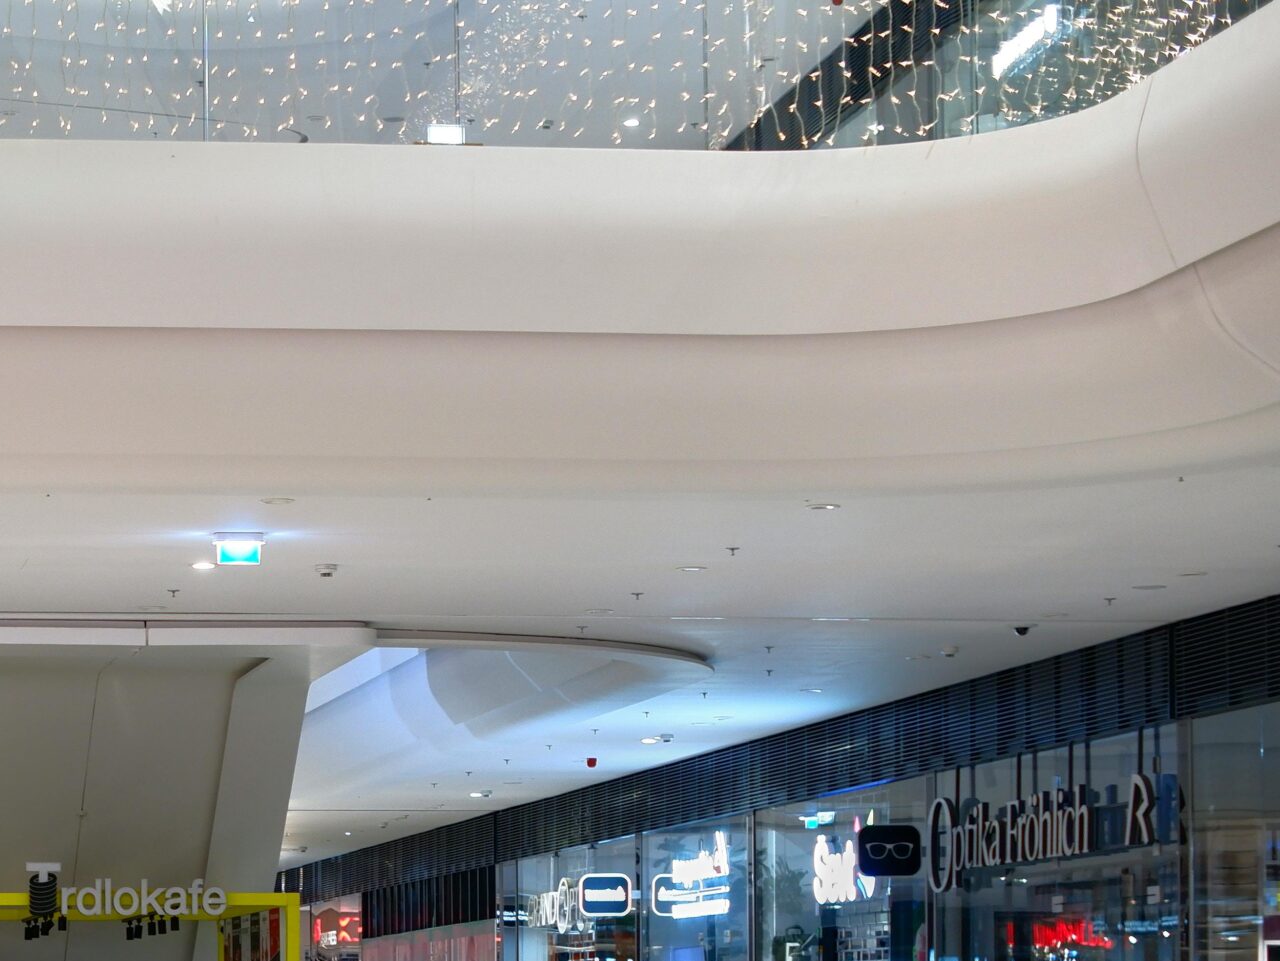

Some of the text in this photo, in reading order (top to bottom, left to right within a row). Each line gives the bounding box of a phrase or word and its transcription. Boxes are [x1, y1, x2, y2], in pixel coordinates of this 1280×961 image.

[927, 784, 1090, 893] Optika Fröhlich
[26, 862, 227, 917] Trdlokafe
